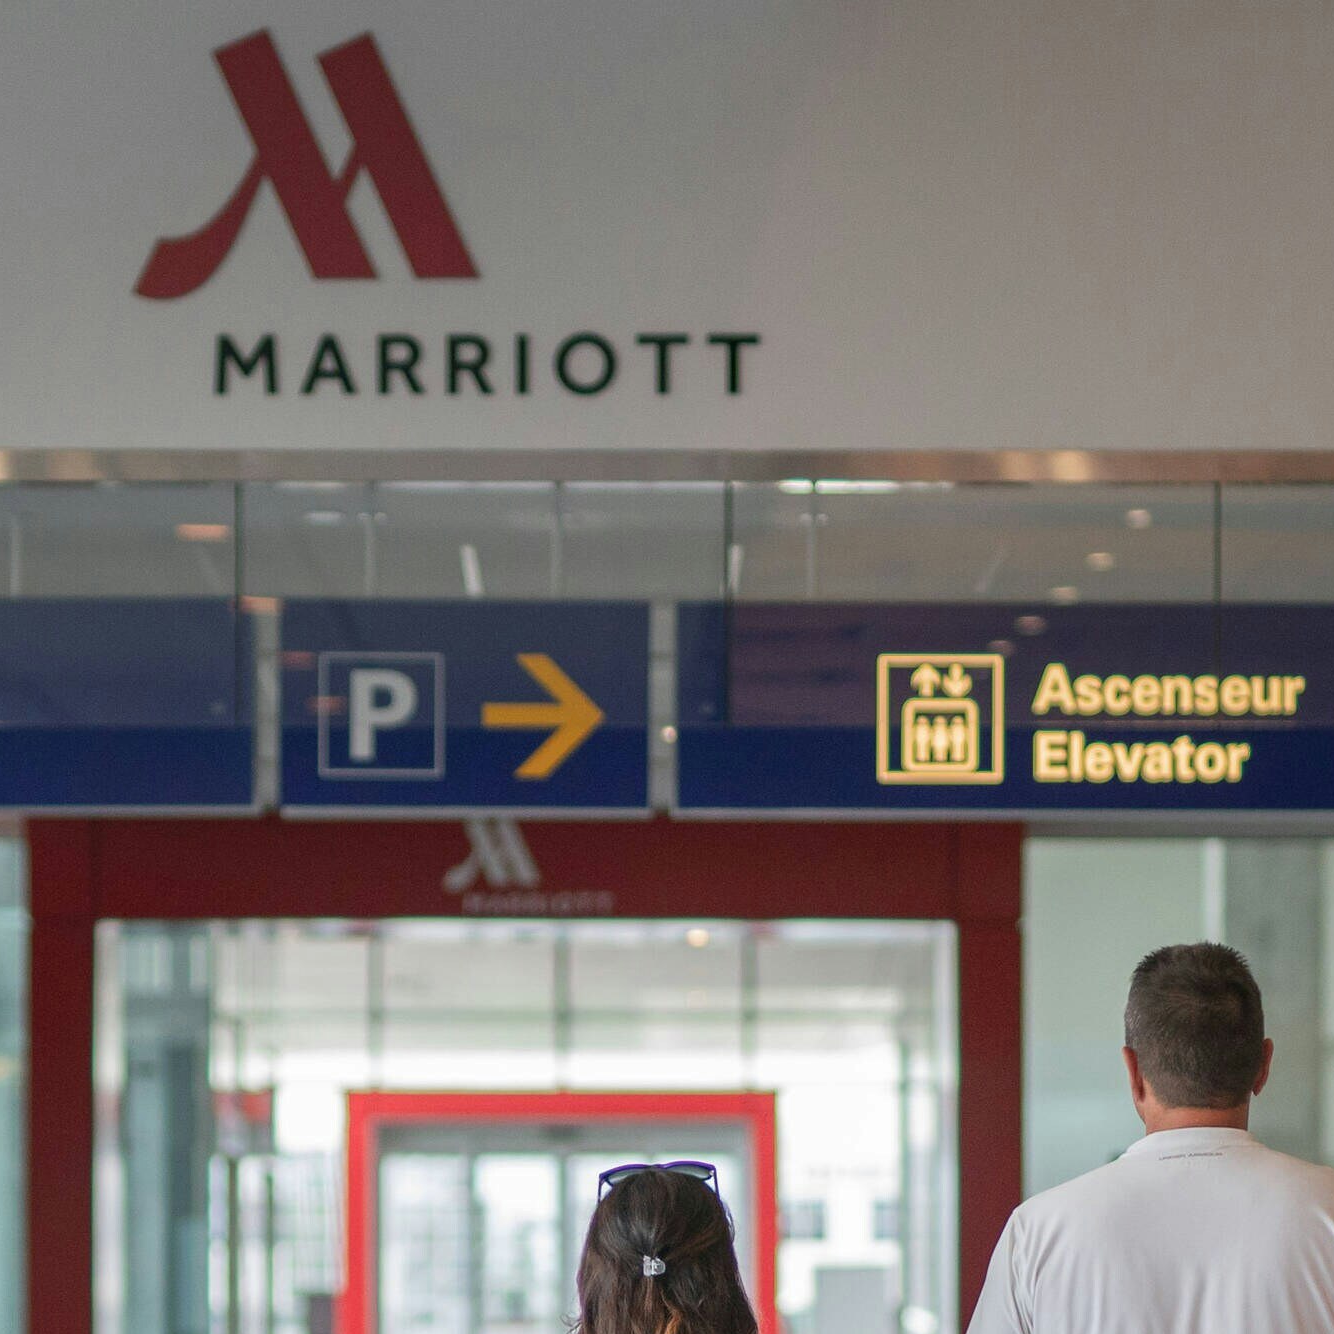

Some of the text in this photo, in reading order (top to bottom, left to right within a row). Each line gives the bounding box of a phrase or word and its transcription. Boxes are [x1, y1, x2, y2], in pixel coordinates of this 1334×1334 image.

[213, 333, 761, 395] MARRIOTT
[349, 668, 418, 761] P
[1031, 662, 1306, 716] Ascenseur
[1033, 730, 1251, 784] Elevator
